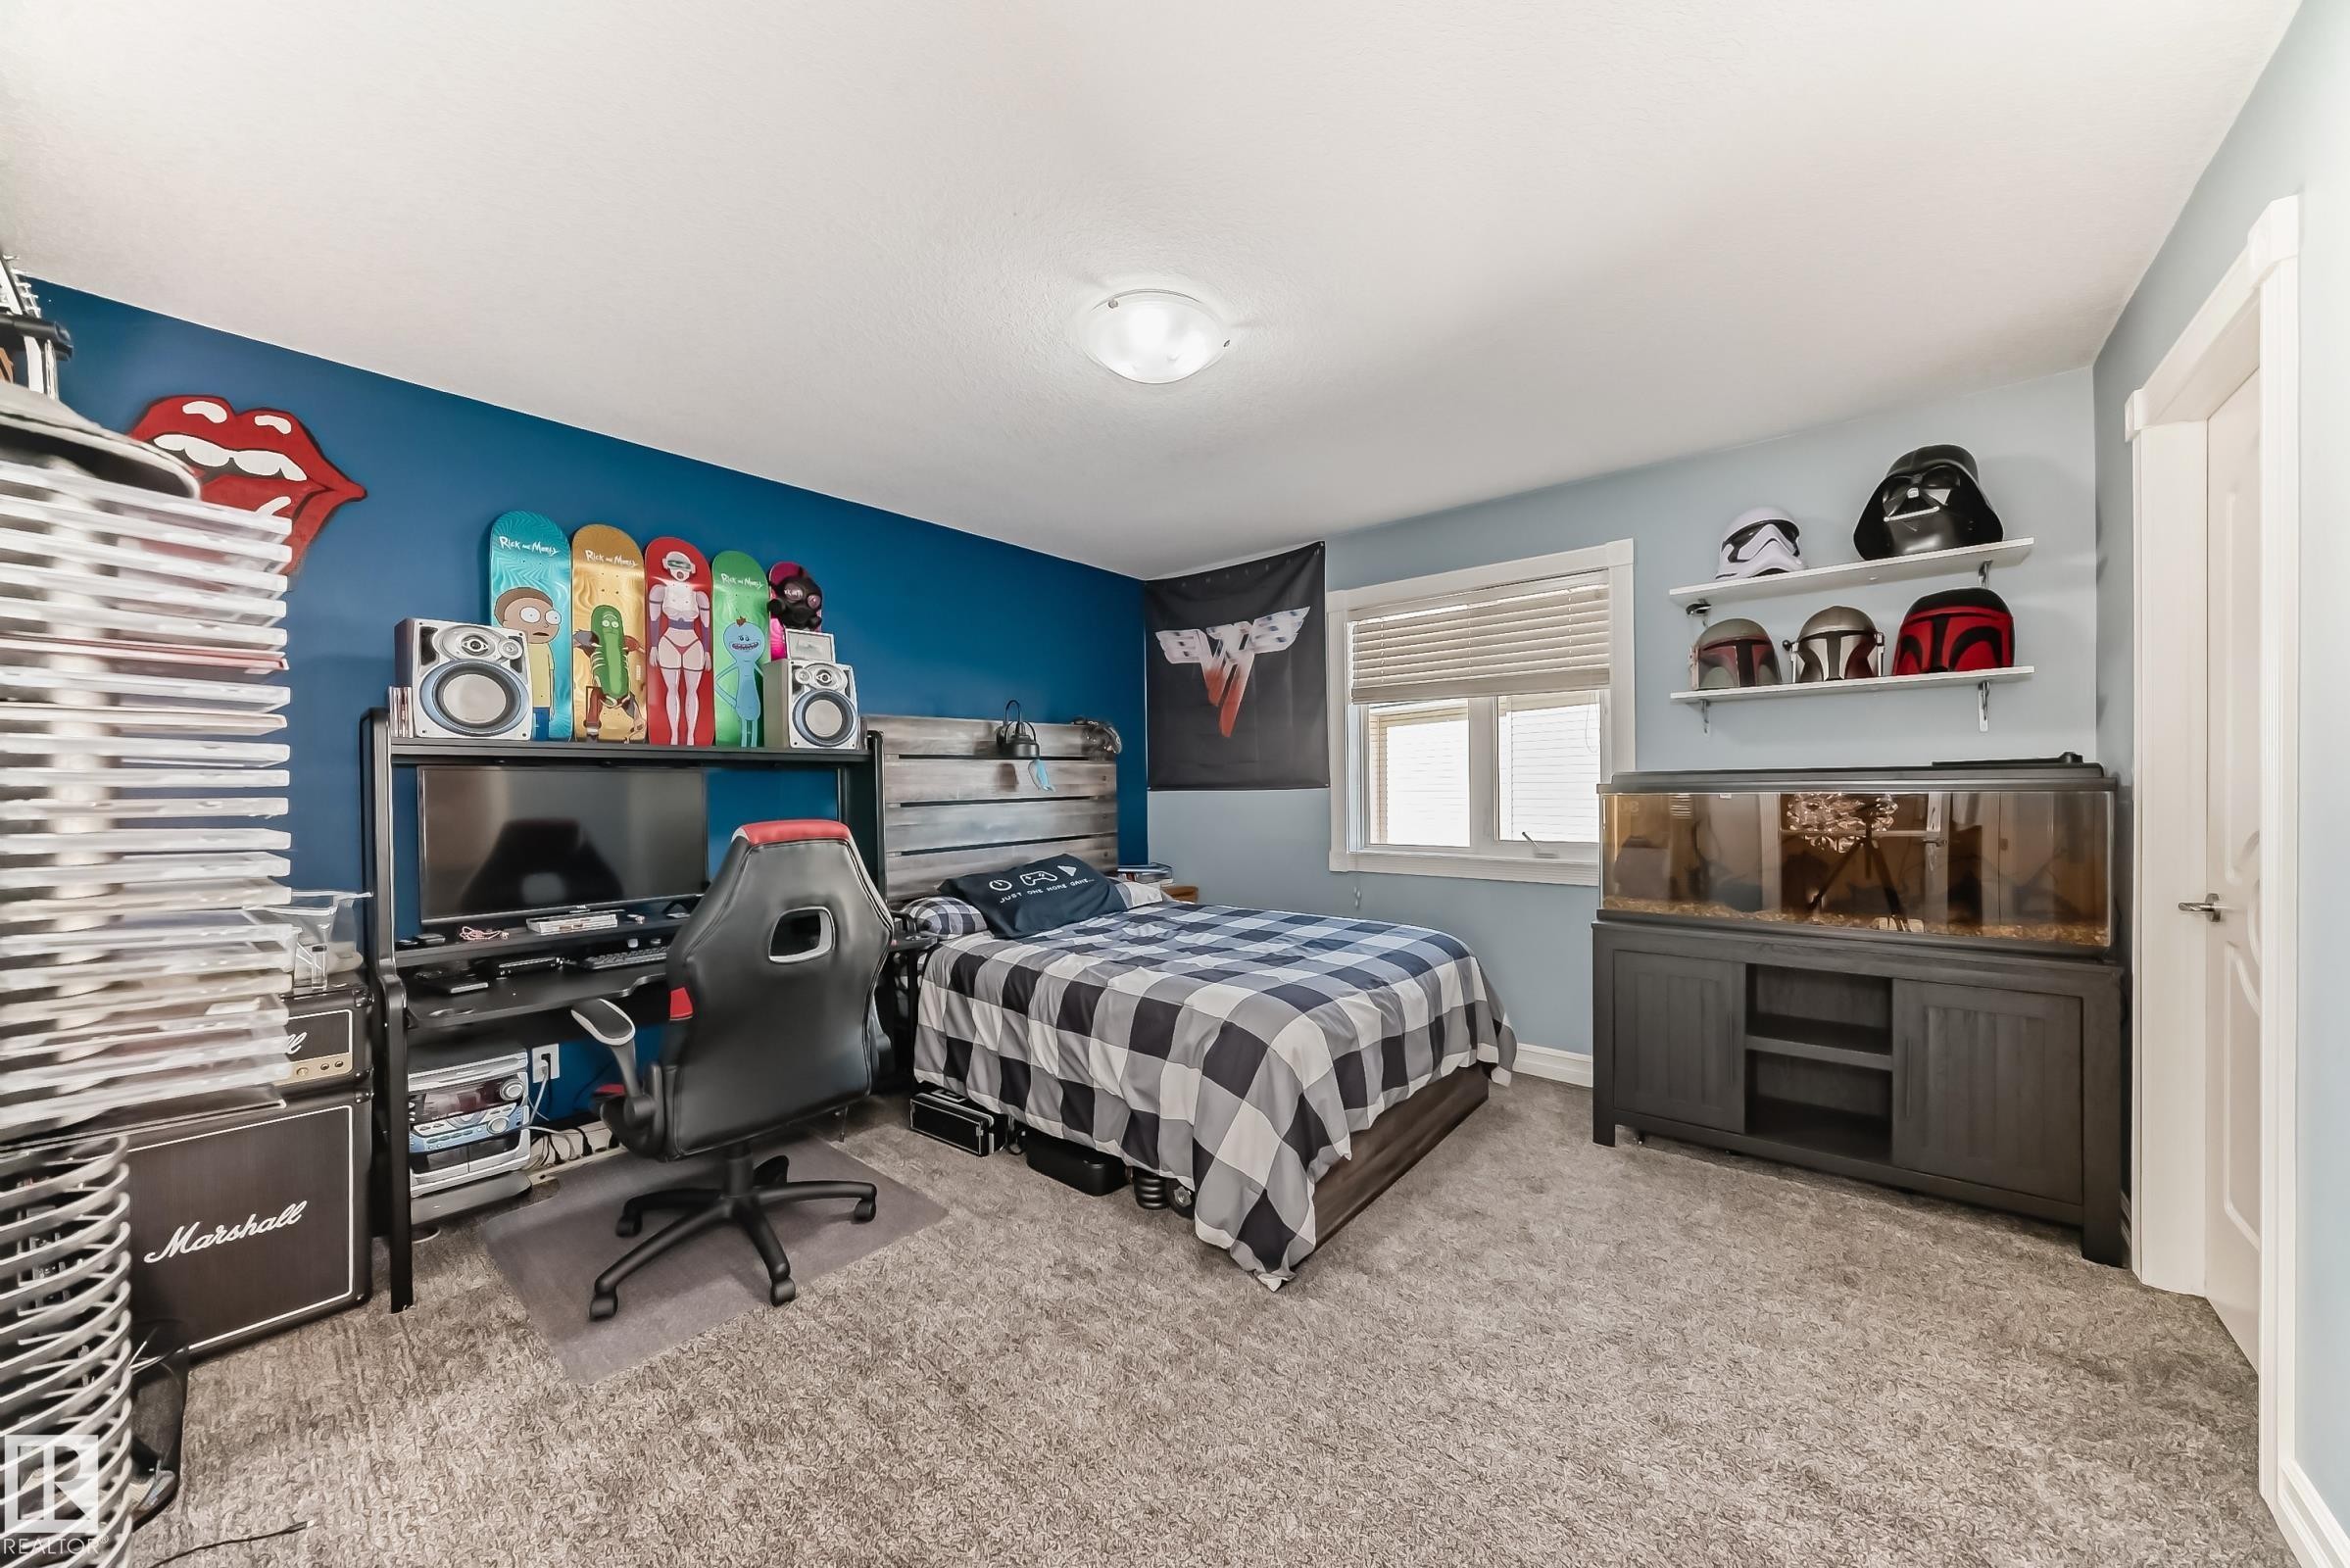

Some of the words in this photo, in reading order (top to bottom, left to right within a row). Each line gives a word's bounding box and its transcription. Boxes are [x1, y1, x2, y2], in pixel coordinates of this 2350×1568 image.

[1000, 892, 1023, 904] JUST
[1046, 883, 1068, 893] MORE
[143, 1200, 309, 1264] Marshall
